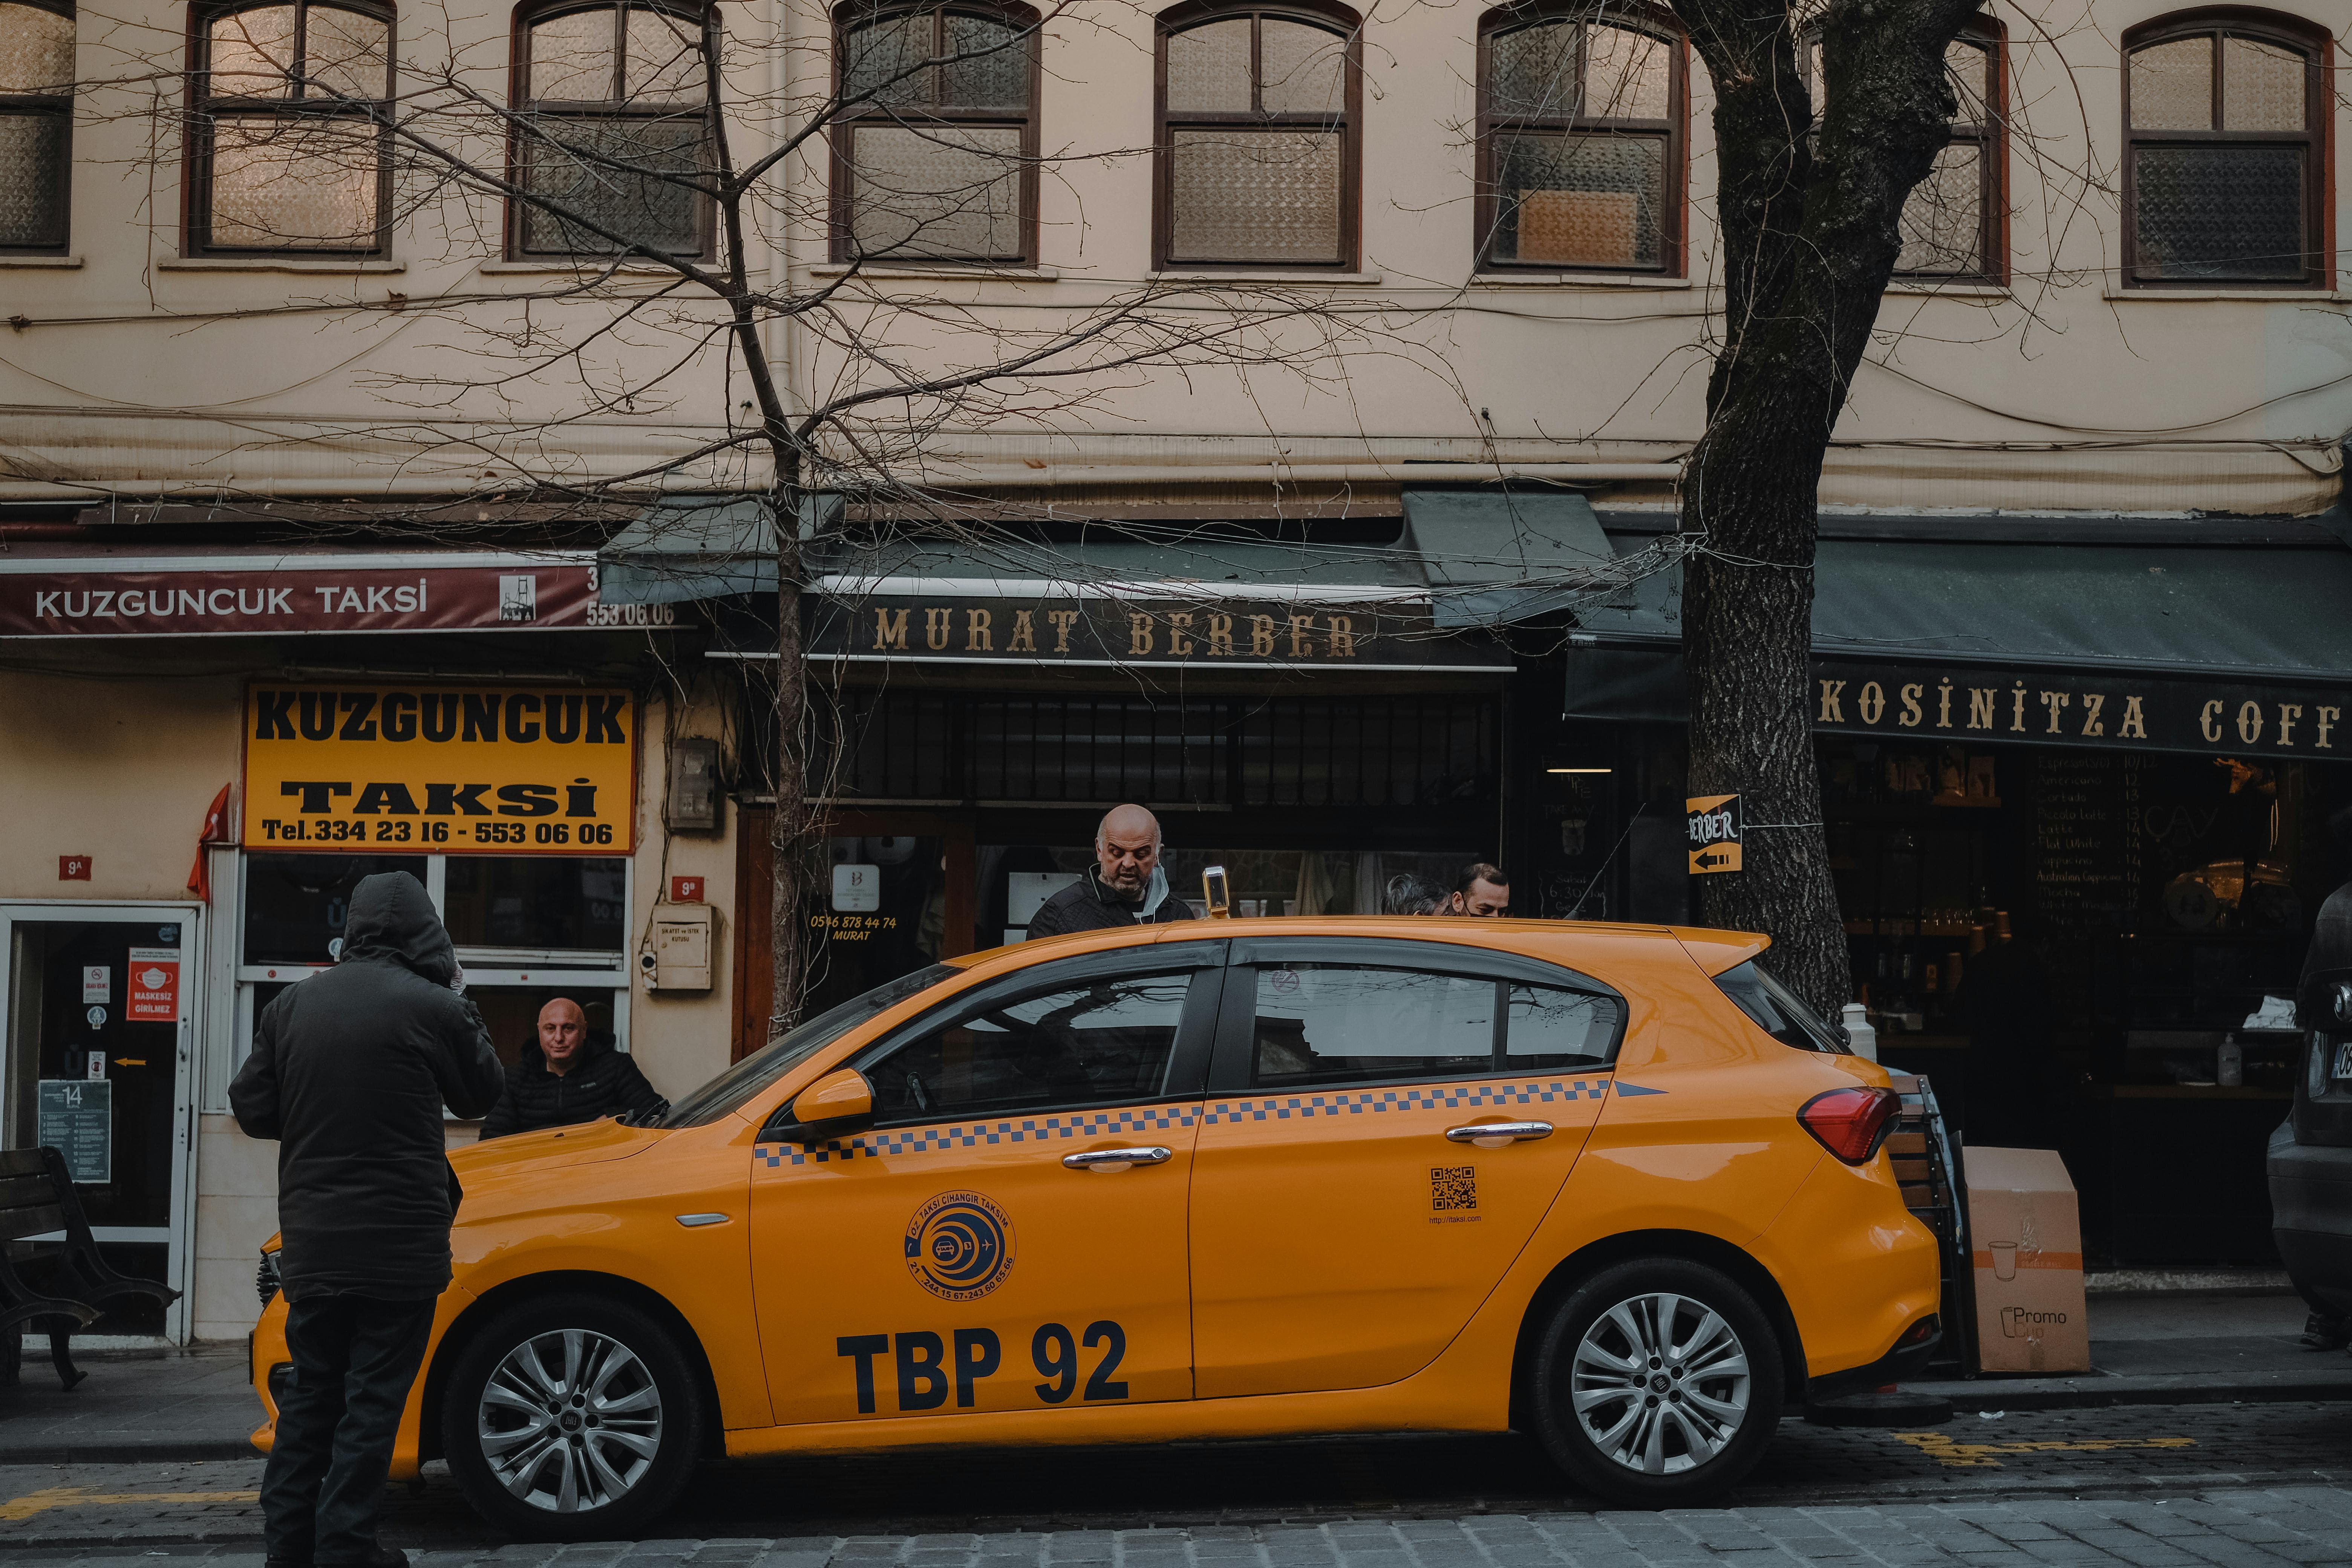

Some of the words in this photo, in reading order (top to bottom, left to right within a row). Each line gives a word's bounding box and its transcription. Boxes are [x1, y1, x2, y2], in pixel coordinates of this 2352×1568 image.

[36, 588, 294, 617] KUZGUNCUK
[315, 578, 427, 614] TAKSİ
[587, 601, 619, 626] 553
[625, 603, 647, 625] 06
[873, 608, 1078, 652] MURAT
[1128, 613, 1356, 657] BERBER
[256, 691, 626, 744] KUZGUNCUK
[1818, 677, 2147, 739] KOSİNİTZA
[2199, 699, 2341, 749] COFF
[2125, 773, 2141, 786] 12
[280, 778, 597, 817] TAKSİ
[2126, 789, 2139, 801] 13
[2127, 806, 2140, 821] 13
[376, 821, 411, 842] 23
[421, 822, 449, 842] 16
[475, 822, 526, 843] 553
[535, 823, 569, 844] 06
[579, 824, 612, 844] 06
[1689, 811, 1738, 844] BERBER
[842, 917, 863, 928] 878
[865, 917, 879, 928] 44
[883, 917, 897, 929] 74
[833, 931, 871, 941] MURAT
[135, 991, 172, 1000] MASKESİZ
[135, 1003, 170, 1013] GİRİLMEZ
[62, 1086, 83, 1104] 14
[911, 1220, 920, 1236] ÖZ
[919, 1197, 940, 1220] TAKSİ
[942, 1193, 979, 1205] CİHANGİR
[981, 1197, 1009, 1228] TAKSİM
[1429, 1216, 1481, 1225] http://itaksi.com
[941, 1289, 951, 1298] 15
[985, 1281, 995, 1292] 60
[2014, 1307, 2067, 1323] Promo
[836, 1328, 1001, 1415] TBP
[1031, 1320, 1129, 1404] 92
